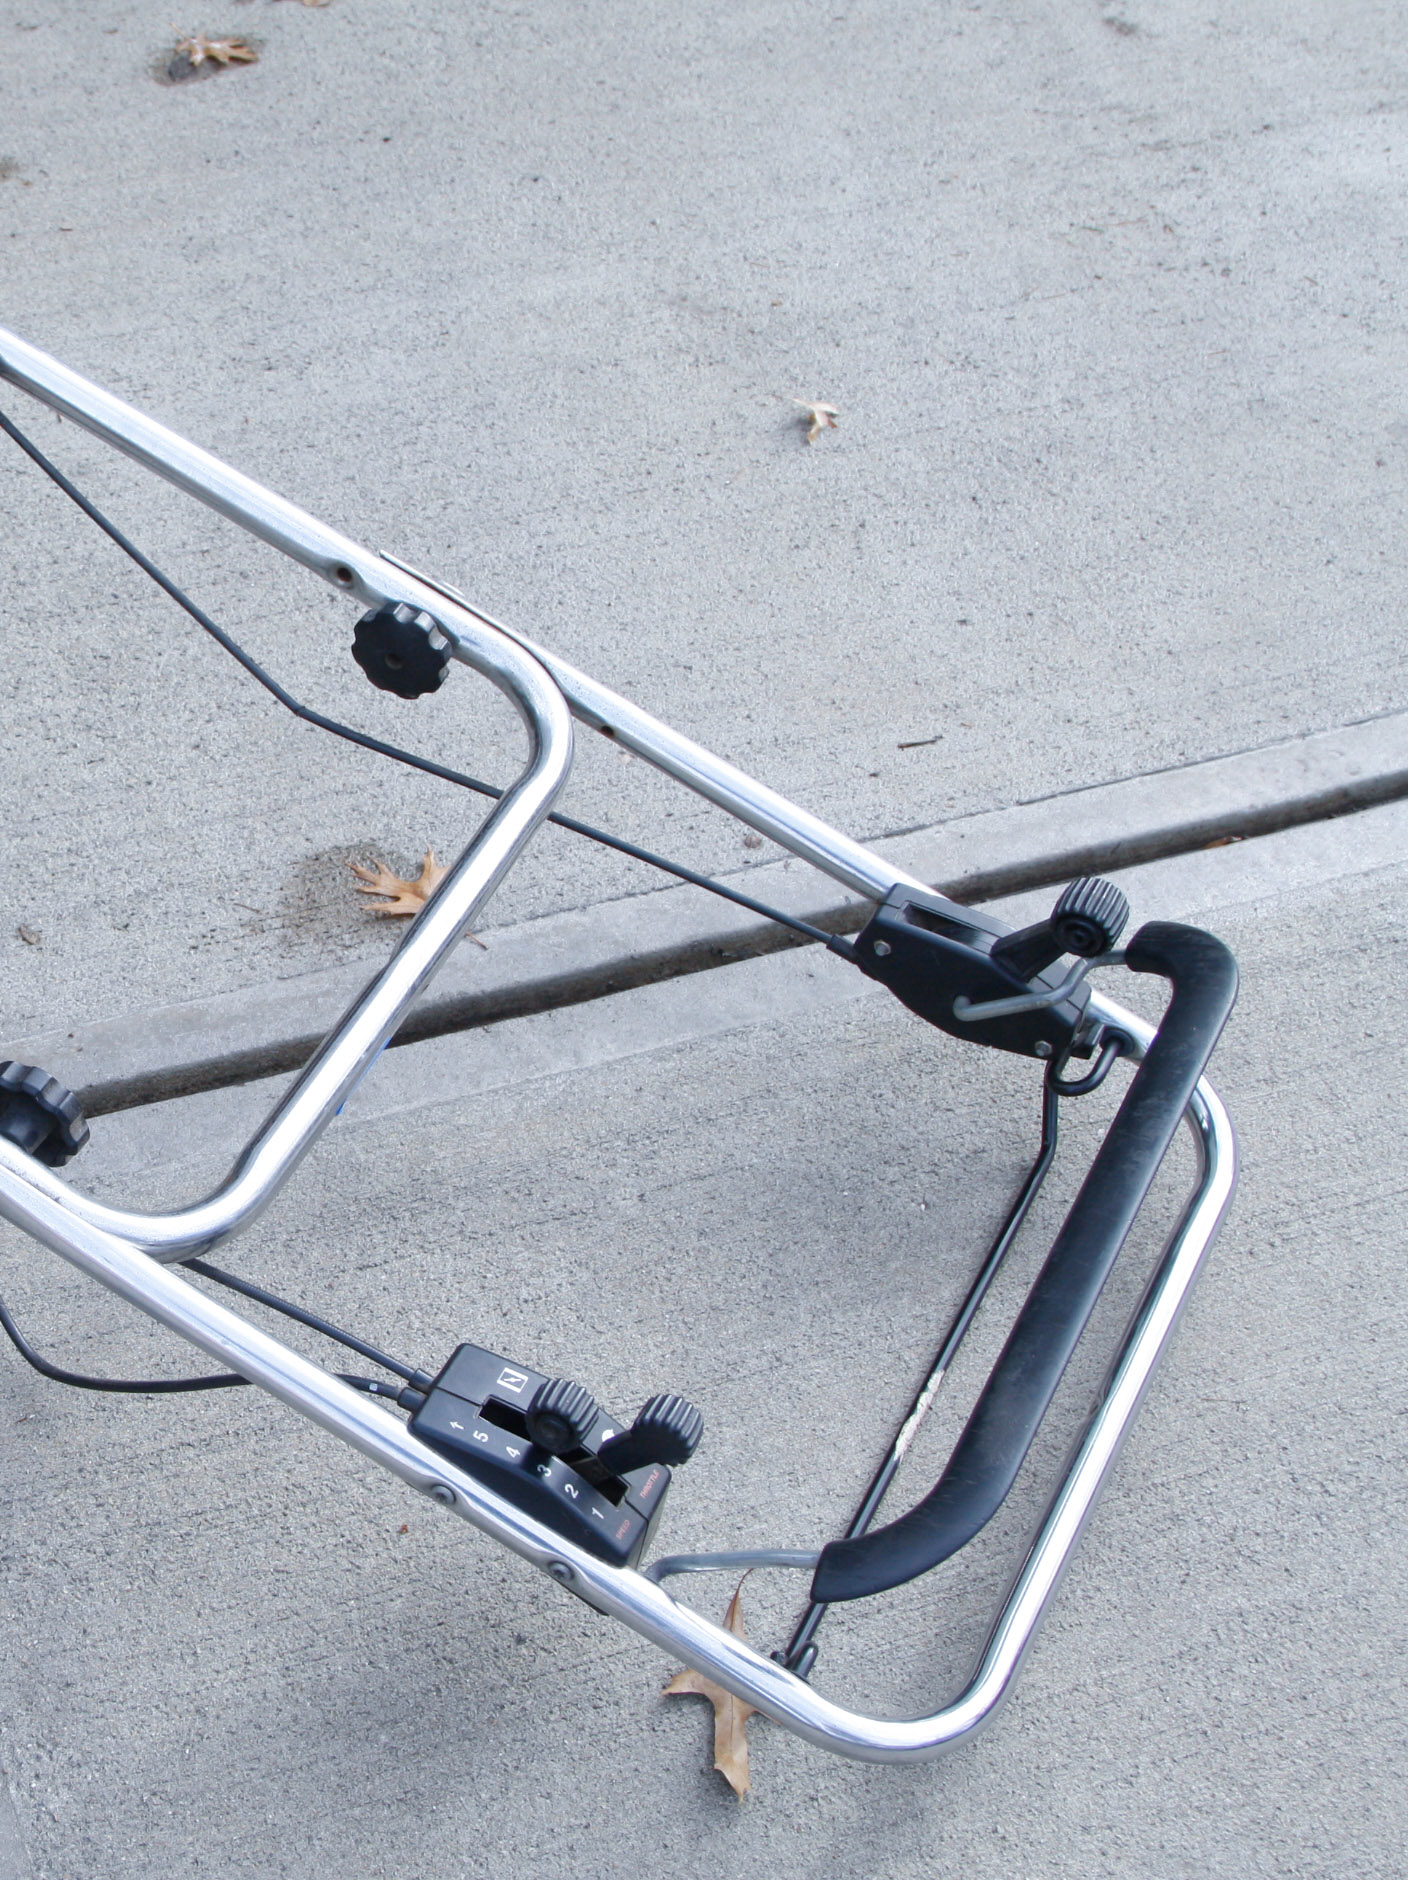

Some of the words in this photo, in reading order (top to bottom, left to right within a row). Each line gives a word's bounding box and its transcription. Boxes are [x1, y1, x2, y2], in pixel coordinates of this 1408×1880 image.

[472, 1429, 489, 1443] 5
[505, 1446, 521, 1458] 4
[537, 1463, 552, 1478] 3
[564, 1483, 579, 1499] 2
[639, 1468, 660, 1499] THROTTLE
[591, 1506, 604, 1520] 1
[615, 1518, 631, 1540] SPEED
